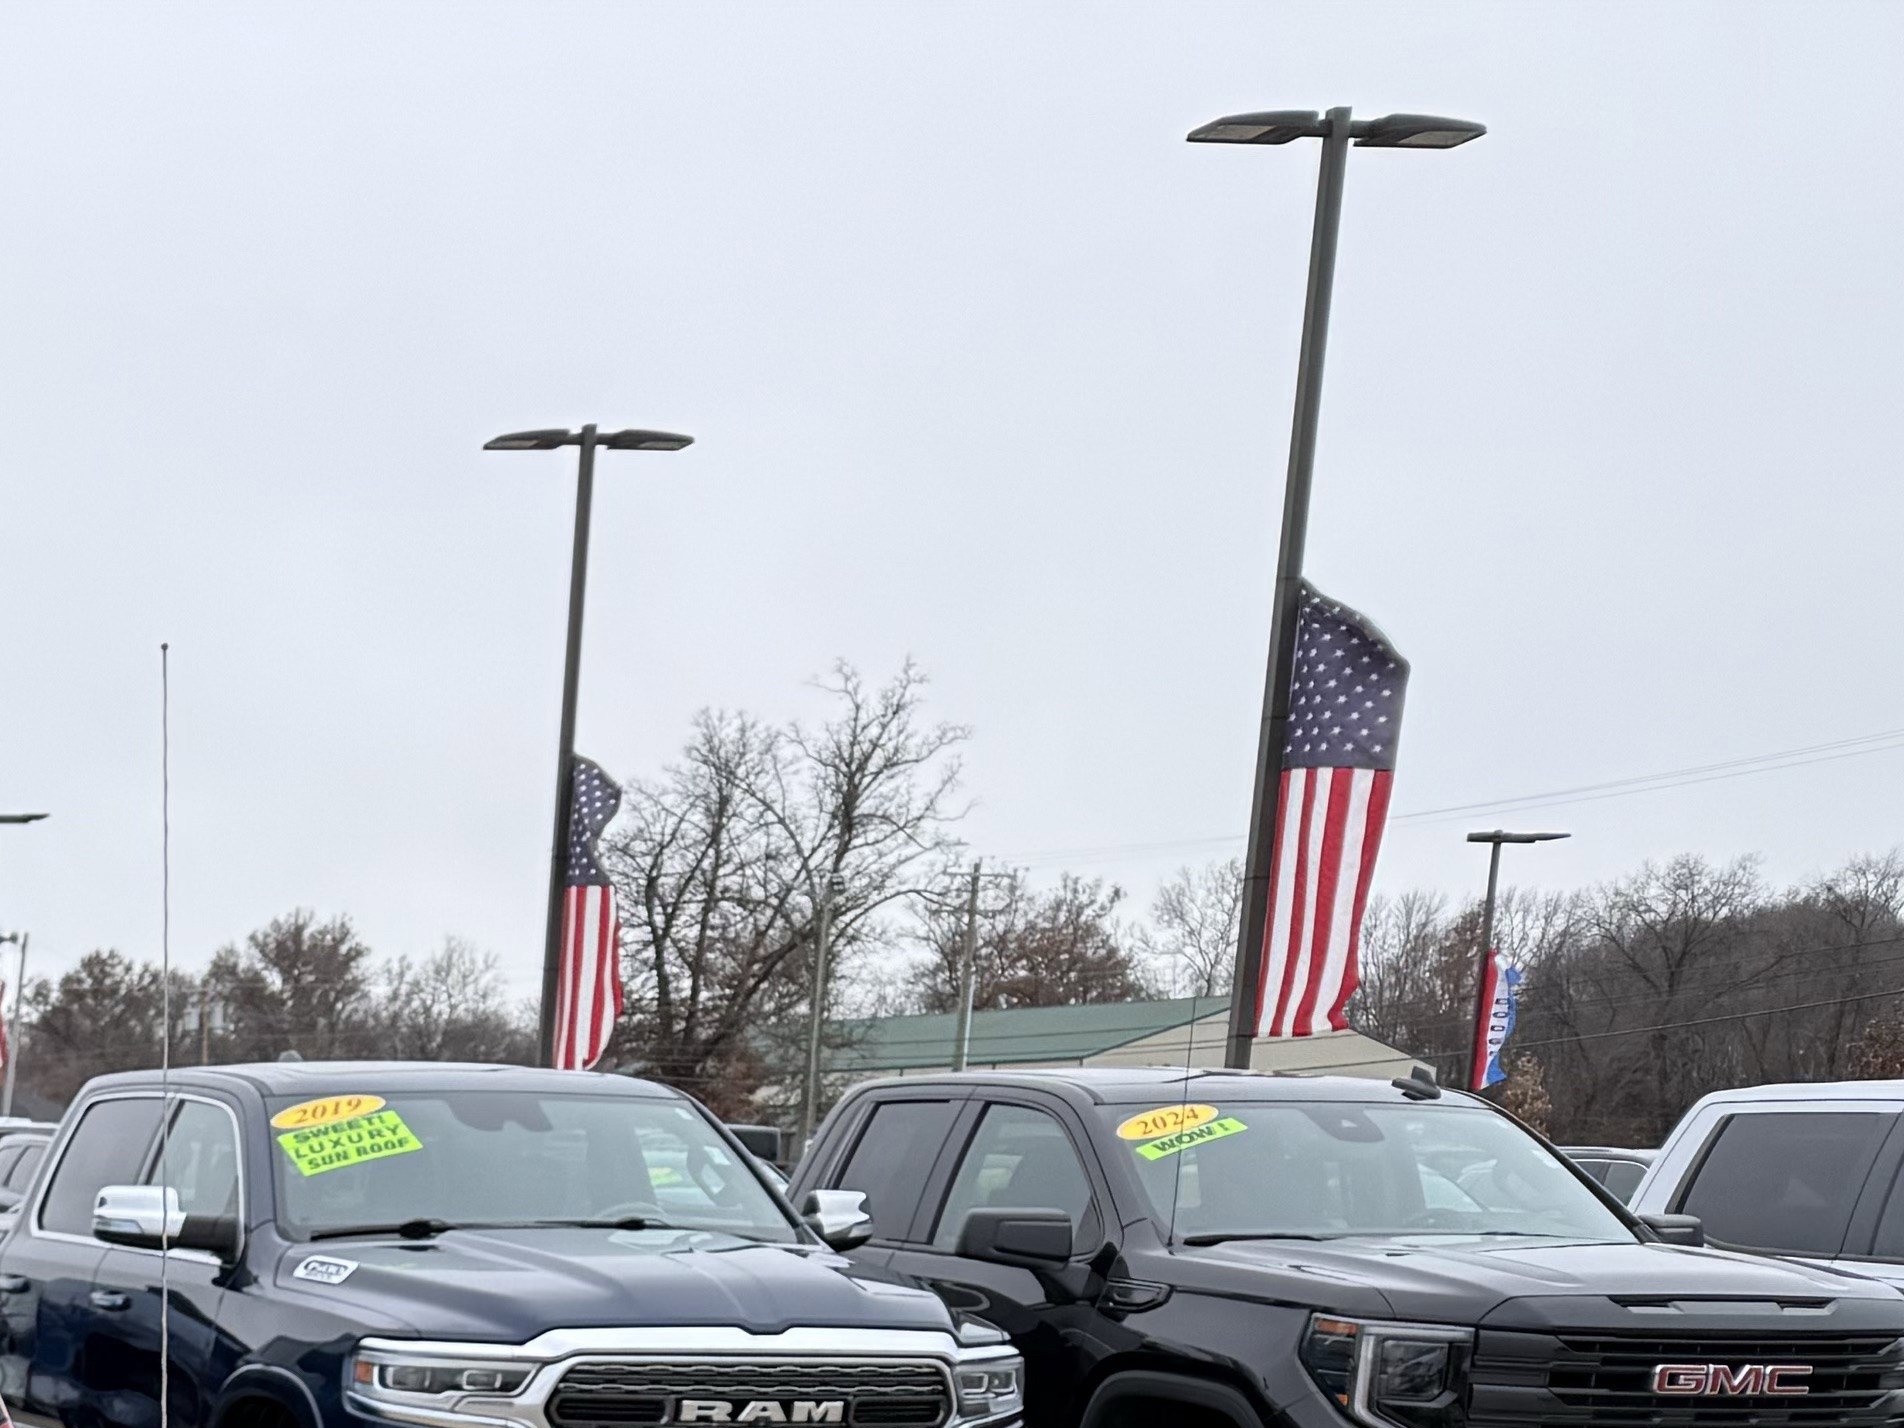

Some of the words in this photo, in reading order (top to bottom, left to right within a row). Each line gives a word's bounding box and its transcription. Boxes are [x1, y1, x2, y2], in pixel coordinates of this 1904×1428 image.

[293, 1097, 362, 1124] 2019
[1136, 1108, 1199, 1135] 2024
[294, 1124, 400, 1160] LUXURY
[307, 1150, 350, 1170] SUN
[356, 1137, 409, 1157] ROOF
[1653, 1364, 1814, 1395] GMC
[679, 1400, 845, 1422] RAM
